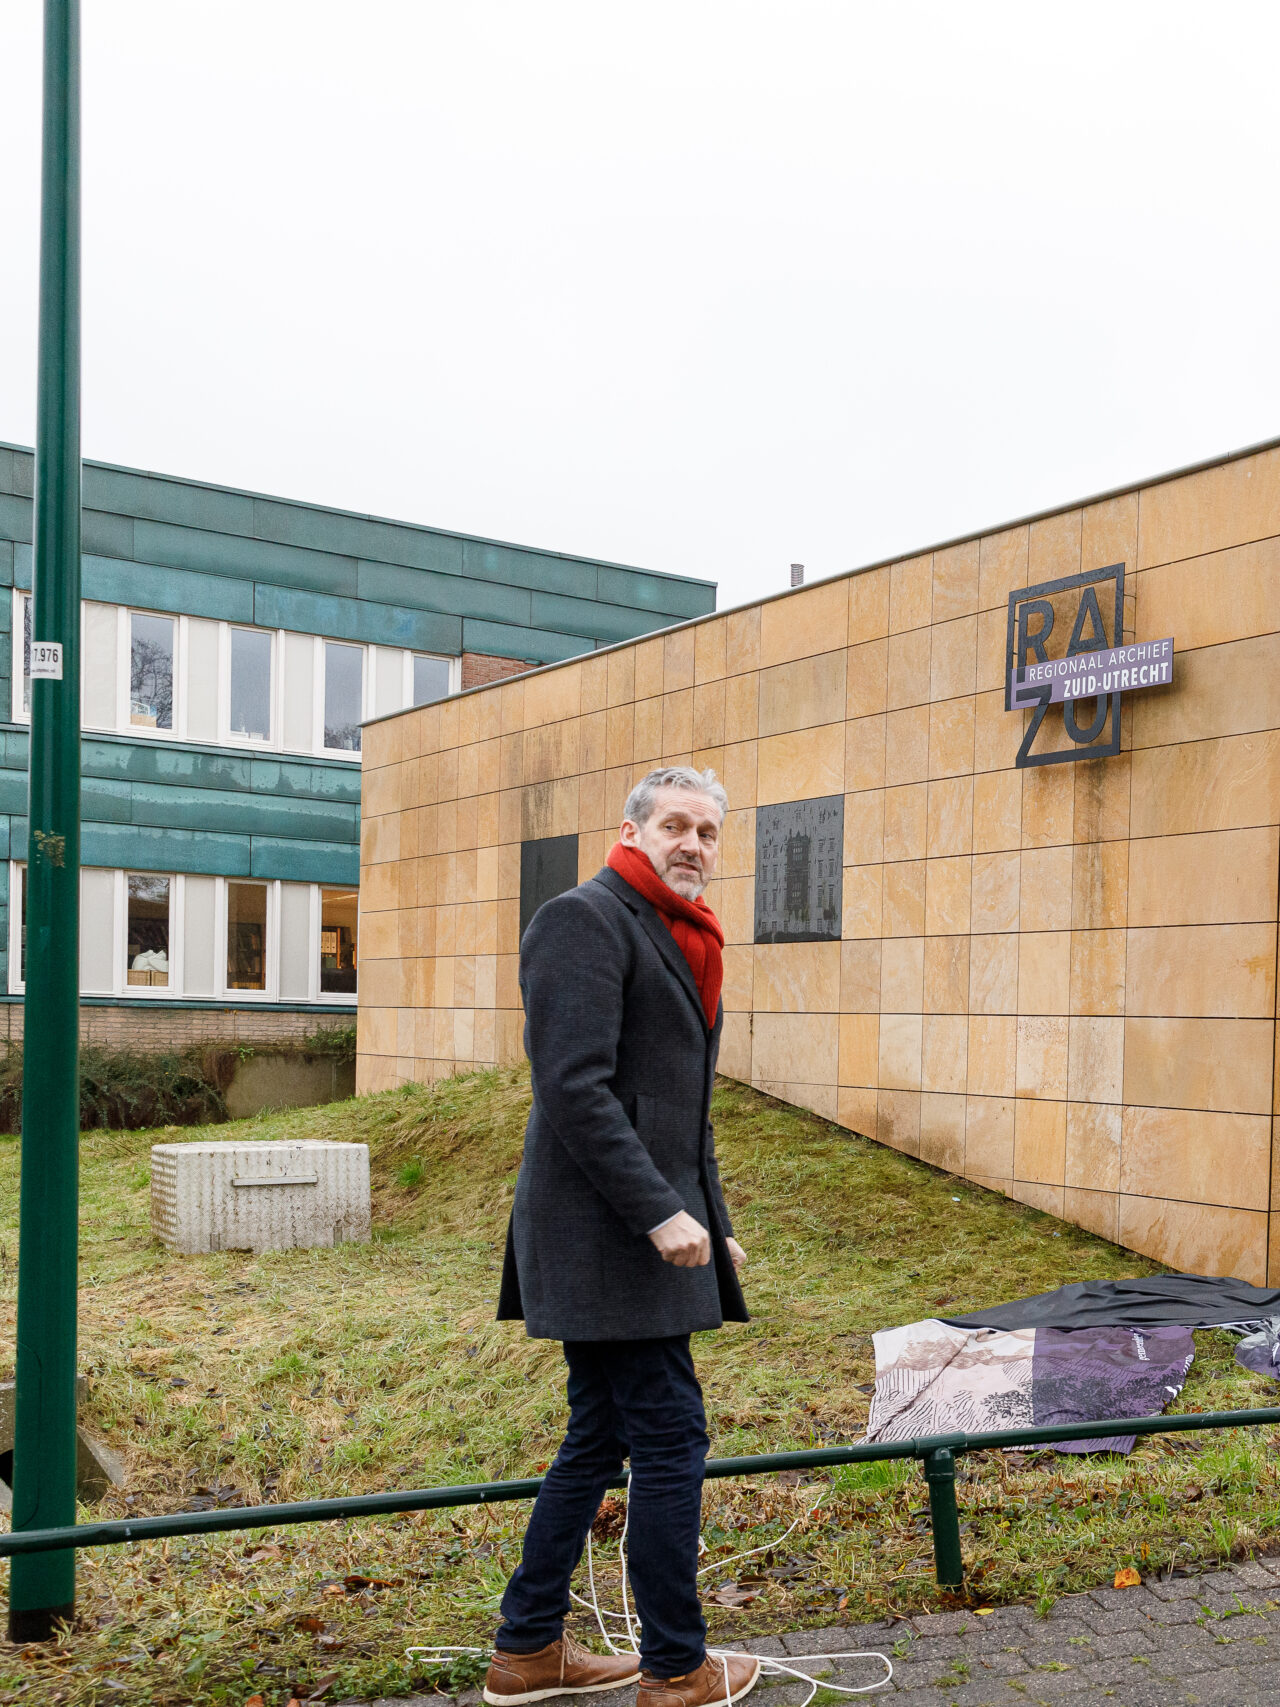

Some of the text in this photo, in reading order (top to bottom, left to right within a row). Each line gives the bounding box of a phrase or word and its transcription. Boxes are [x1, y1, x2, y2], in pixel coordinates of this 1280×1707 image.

[1029, 641, 1169, 682] REGIONAAL ARCHIEF
[1063, 662, 1169, 698] ZUID-UTRECHT
